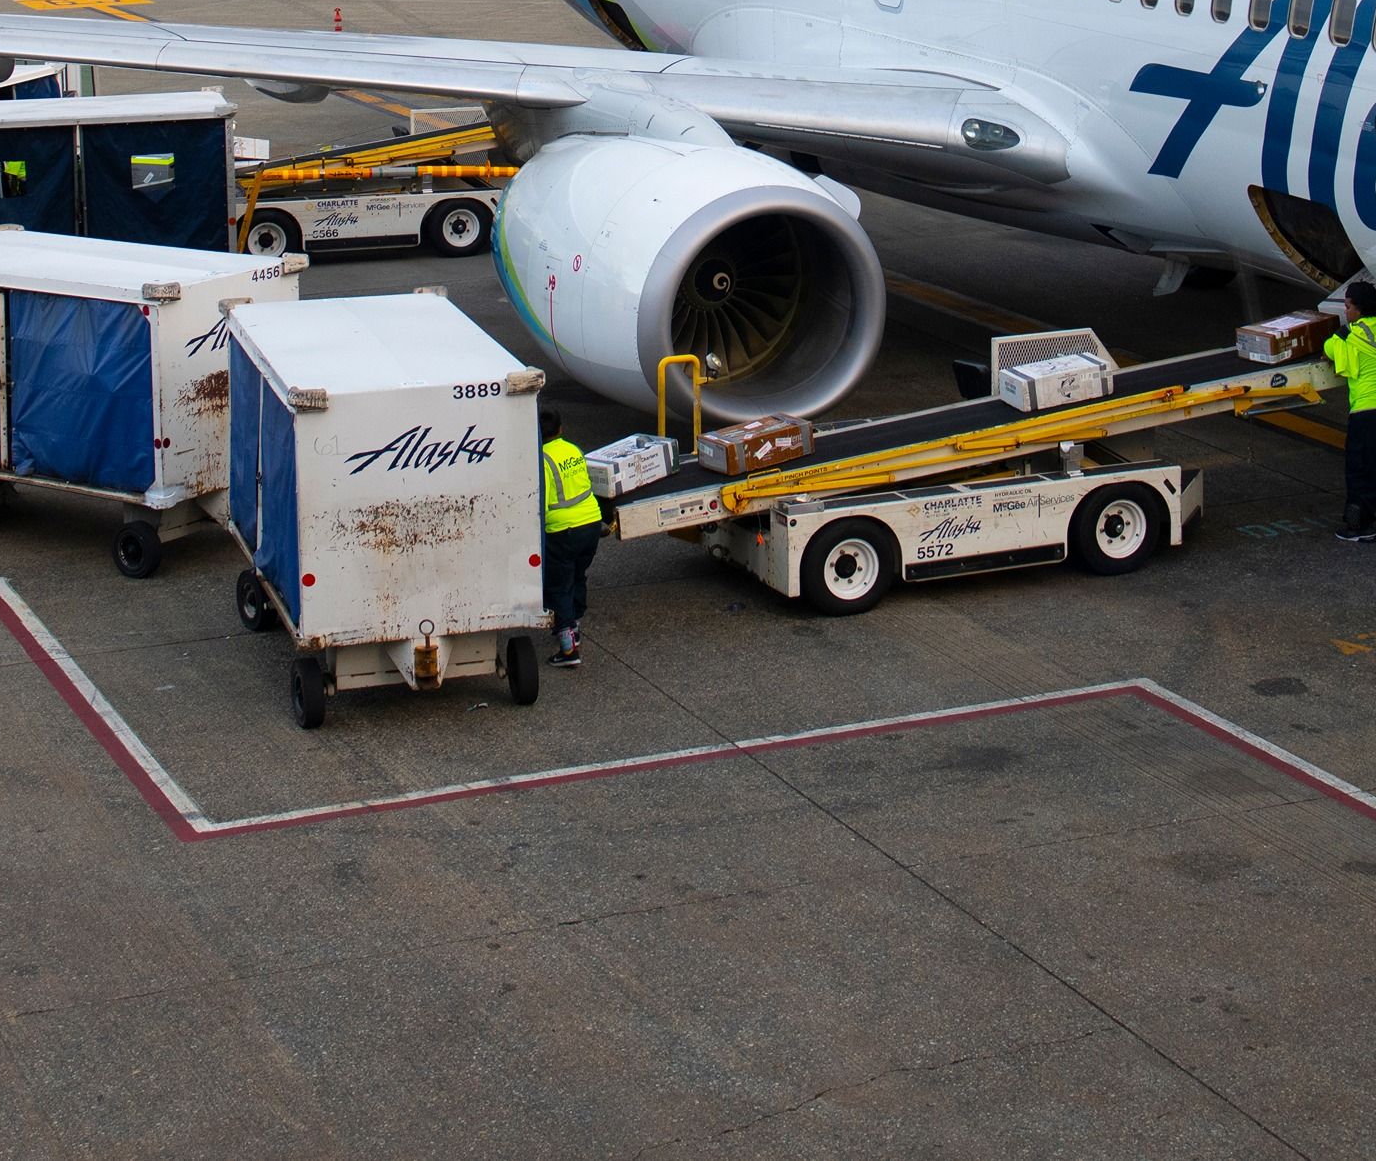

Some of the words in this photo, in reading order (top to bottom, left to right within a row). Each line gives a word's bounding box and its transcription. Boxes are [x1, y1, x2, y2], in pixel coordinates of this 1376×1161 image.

[317, 199, 359, 208] CHARLATTE
[313, 212, 359, 227] Alaska
[251, 265, 280, 283] 4456
[452, 382, 501, 400] 3889
[343, 424, 495, 475] Alaska
[784, 473, 802, 481] PINCH
[802, 467, 828, 478] POINTS
[993, 500, 1026, 513] McGee
[919, 515, 982, 543] Alaska
[917, 543, 954, 560] 5572
